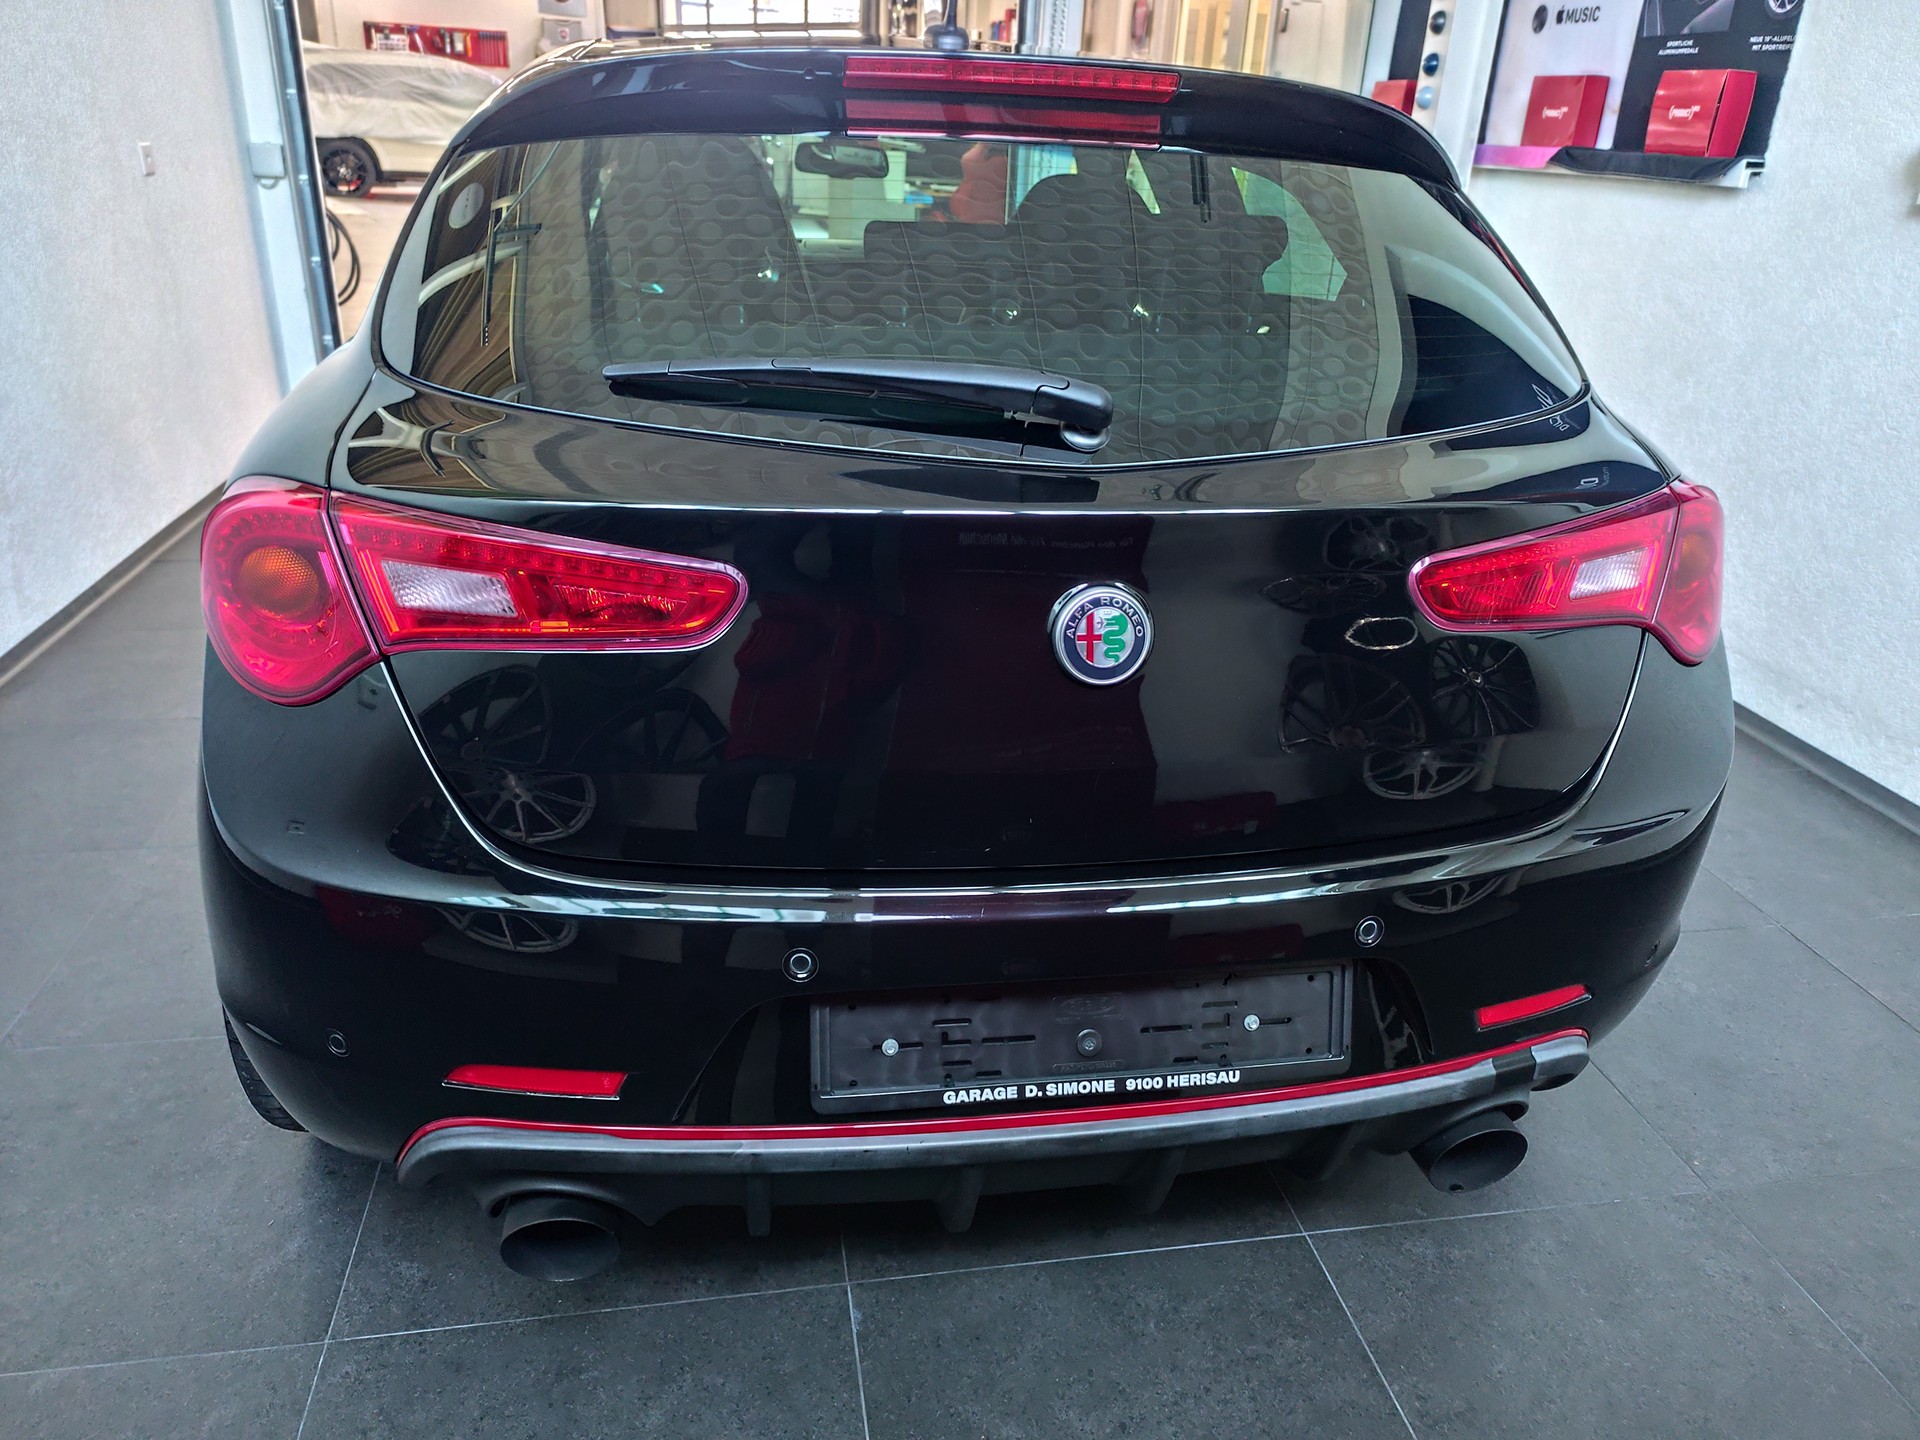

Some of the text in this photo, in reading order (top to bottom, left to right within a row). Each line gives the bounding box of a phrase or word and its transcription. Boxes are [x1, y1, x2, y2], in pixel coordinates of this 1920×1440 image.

[1564, 6, 1601, 24] MUSIC
[1658, 47, 1699, 56] ALUMINIUMPEDALE
[1667, 39, 1694, 48] SPORTLICHE
[1065, 596, 1145, 639] ALFA ROMEO
[943, 1070, 1241, 1105] GARAGE D. SIMONE 9100 HERISAU
